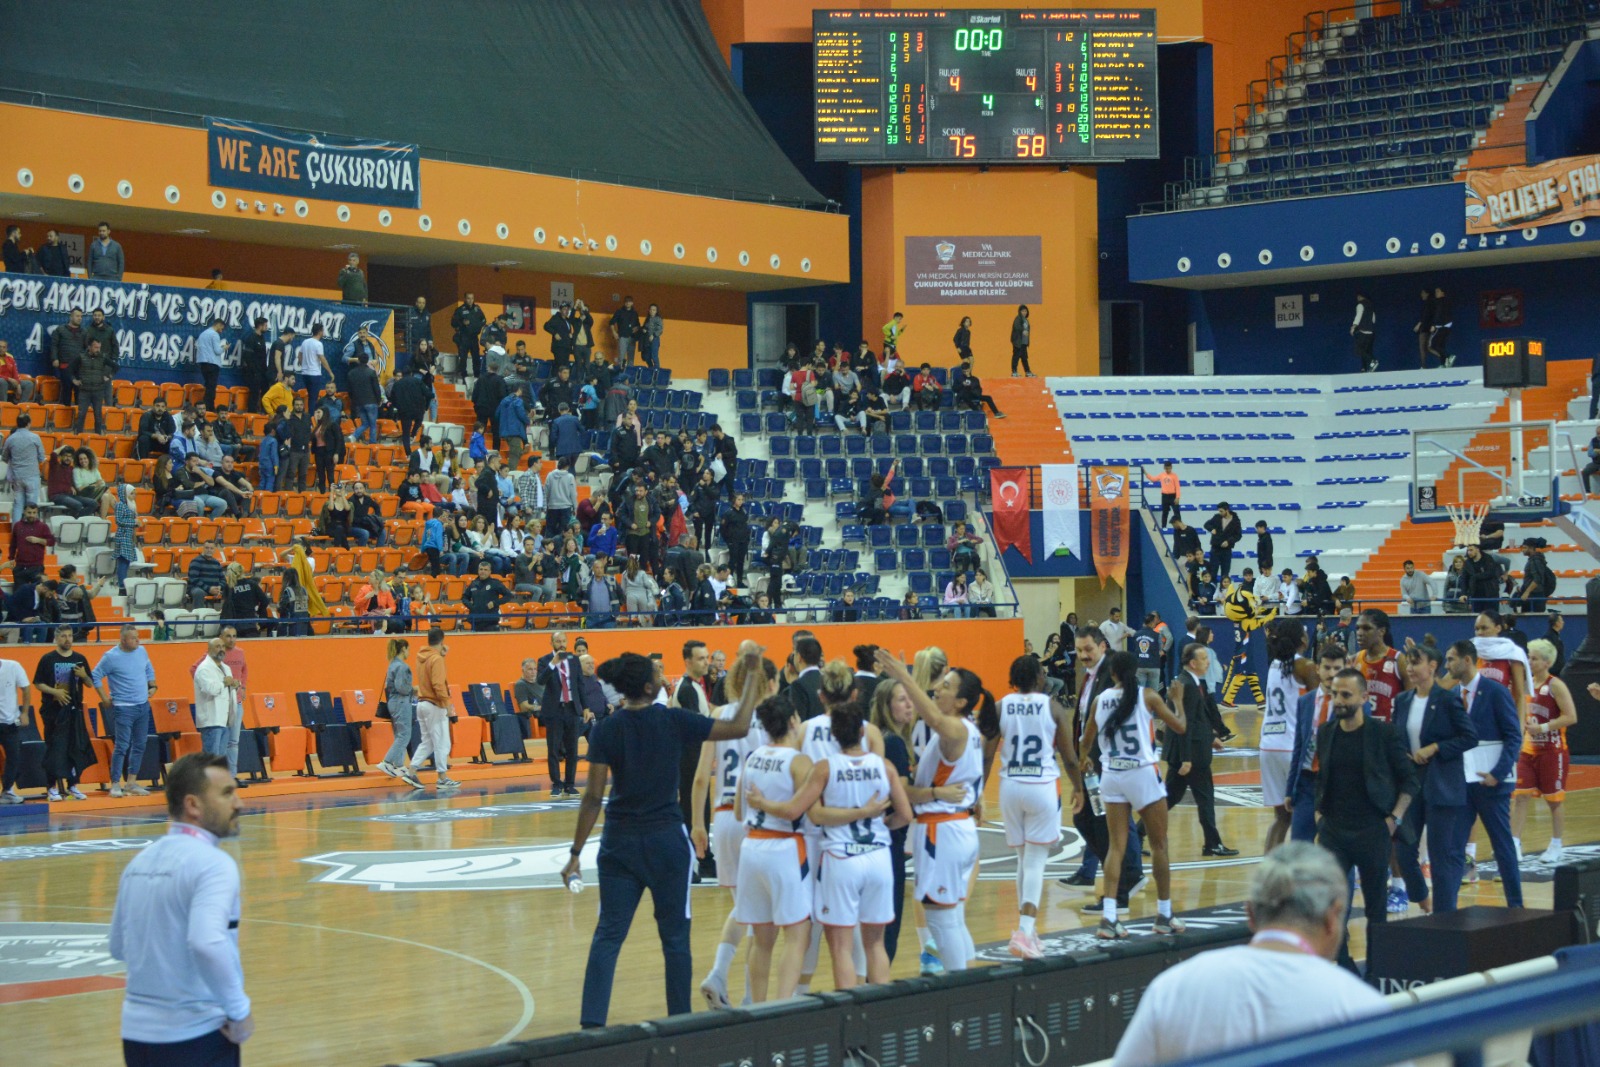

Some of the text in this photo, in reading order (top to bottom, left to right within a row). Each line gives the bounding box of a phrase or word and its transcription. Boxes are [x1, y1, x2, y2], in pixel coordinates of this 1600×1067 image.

[955, 29, 1002, 51] 00:0
[950, 76, 960, 92] 4
[1026, 76, 1036, 91] 4
[982, 95, 993, 110] 4
[942, 128, 966, 136] SCORE
[1012, 128, 1036, 136] SCORE
[949, 136, 976, 158] 75
[1017, 136, 1045, 157] 58
[217, 136, 414, 191] WE ARE ÇUKUROVA
[1486, 177, 1560, 223] BELIEVE
[68, 255, 82, 265] OK
[940, 288, 1007, 297] BAŞARILAR DİLERİZ.
[0, 277, 45, 316] ÇBK
[44, 283, 151, 320] AKADEMİ
[150, 292, 186, 326] VE
[187, 295, 243, 330] SPOR
[1282, 301, 1297, 310] K-1
[1277, 312, 1301, 322] BLOK
[1234, 630, 1242, 643] 3
[1007, 703, 1044, 716] GRAY
[1267, 687, 1286, 717] 13
[1008, 735, 1042, 767] 12
[836, 768, 882, 783] ASENA
